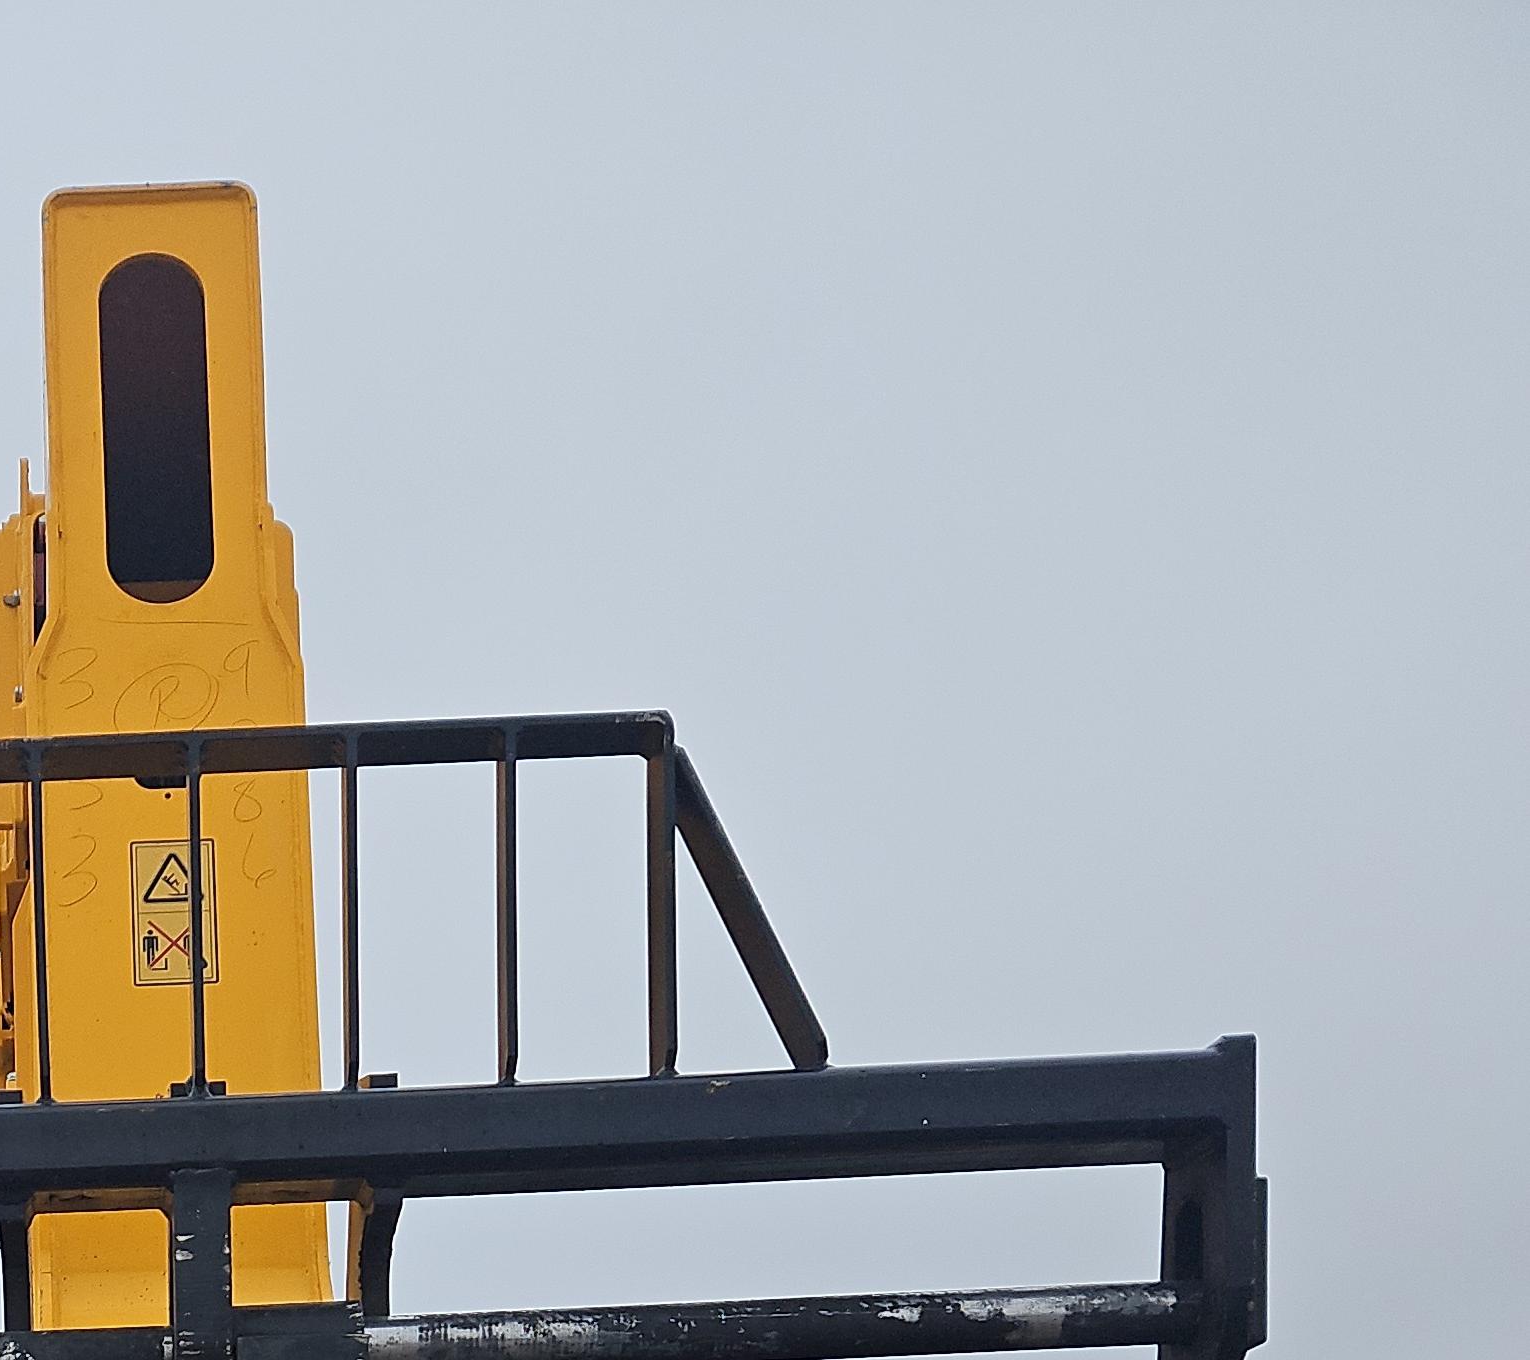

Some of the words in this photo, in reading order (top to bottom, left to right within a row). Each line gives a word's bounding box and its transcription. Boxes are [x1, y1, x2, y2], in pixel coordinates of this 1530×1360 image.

[56, 646, 98, 711] 3
[222, 638, 260, 698] 9
[59, 833, 98, 907] 3
